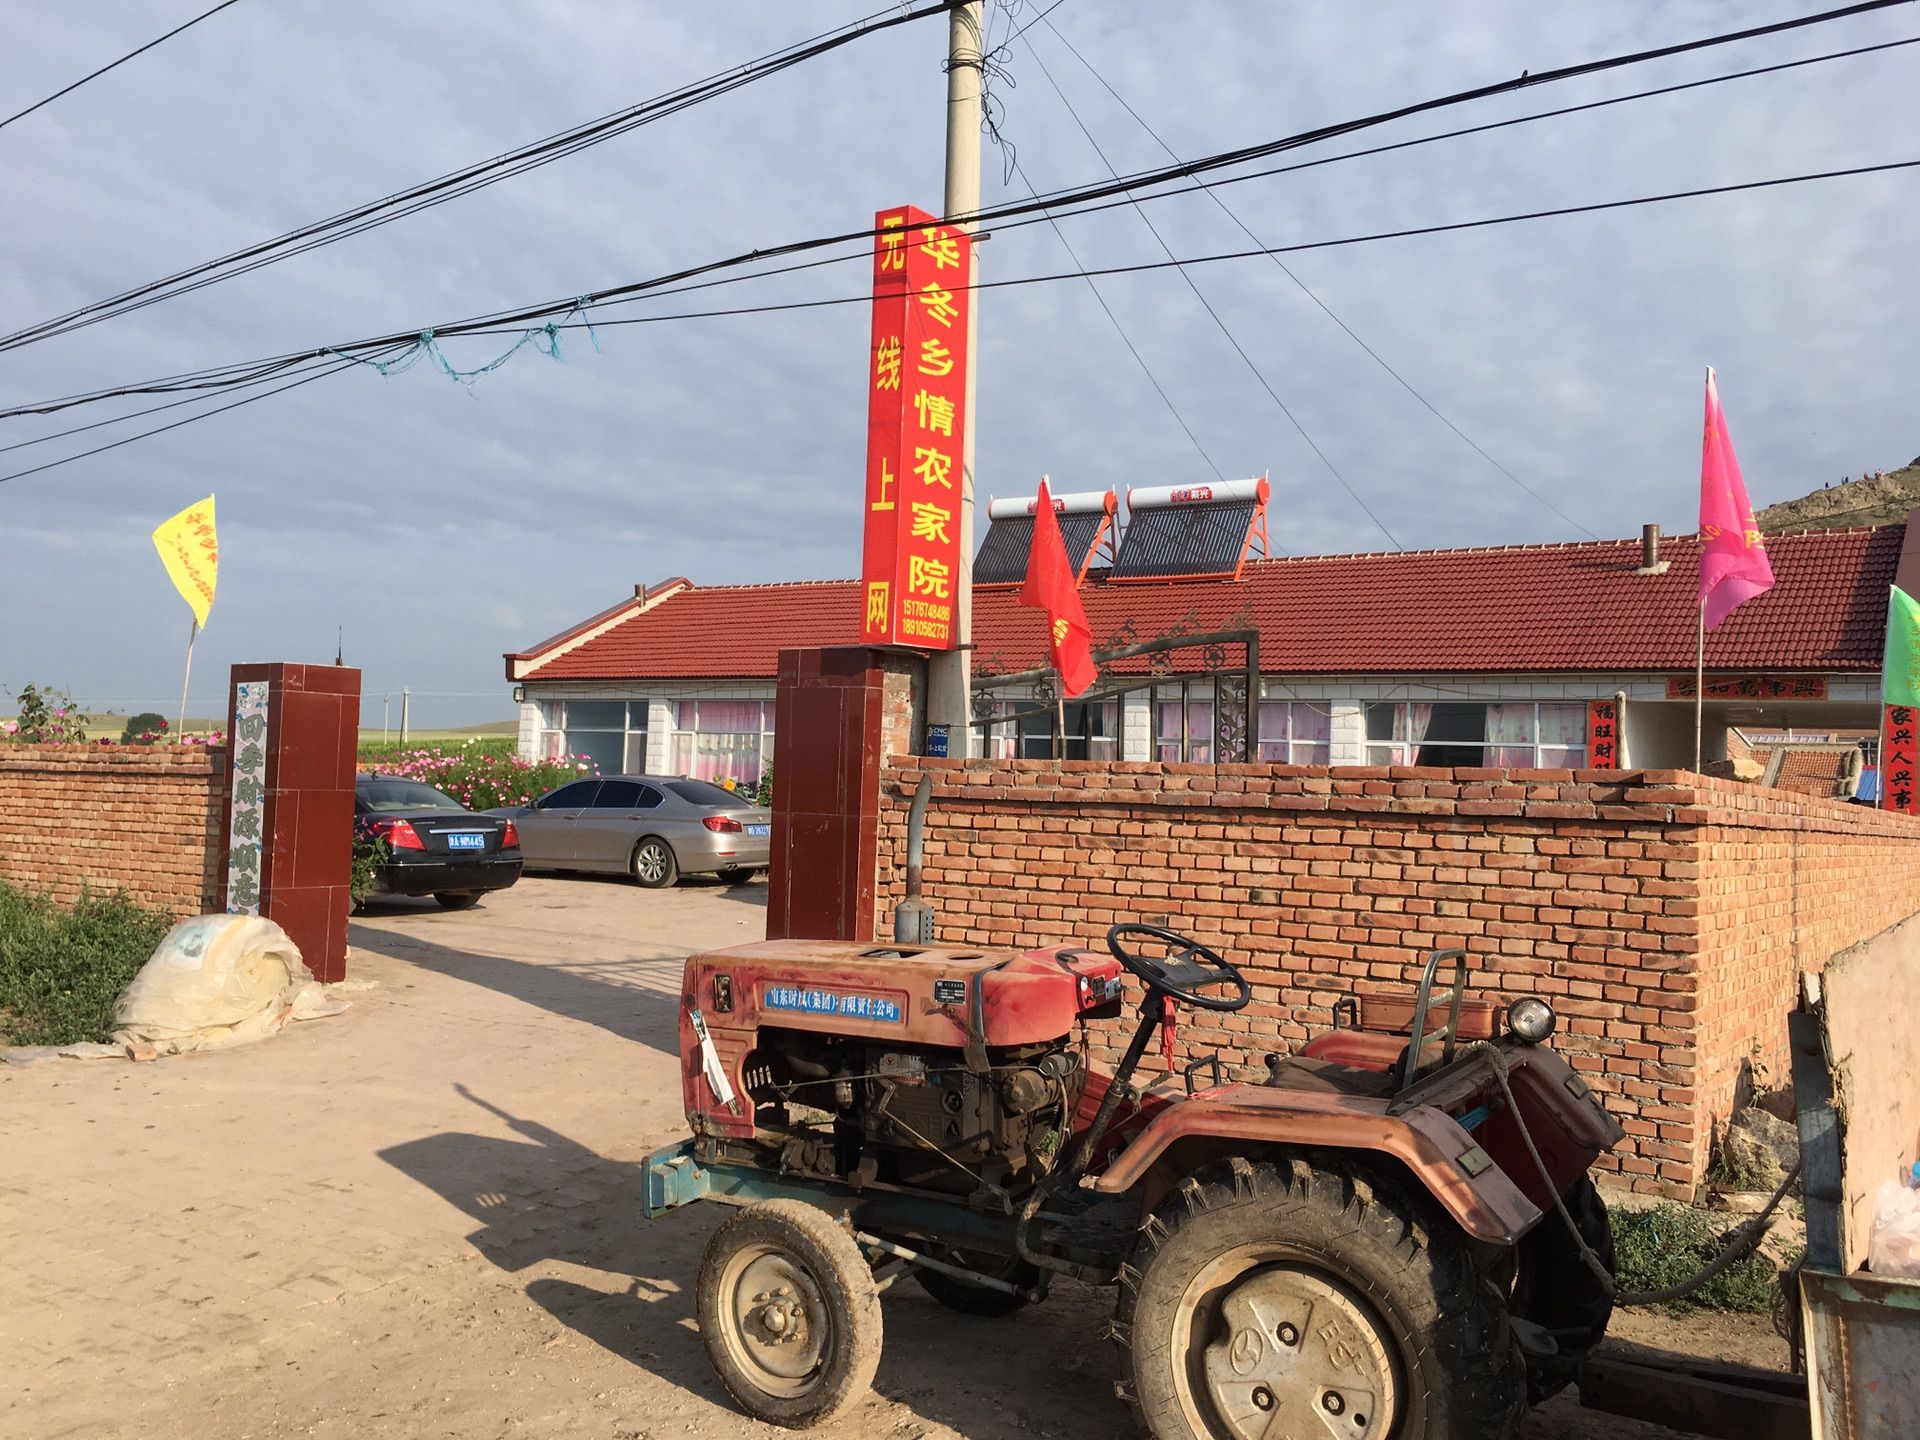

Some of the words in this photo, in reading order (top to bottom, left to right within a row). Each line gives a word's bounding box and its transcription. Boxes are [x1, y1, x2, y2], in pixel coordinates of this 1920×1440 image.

[866, 216, 904, 634] 无线上网
[907, 227, 961, 599] 华冬乡情农家院
[902, 617, 949, 640] 18910582731
